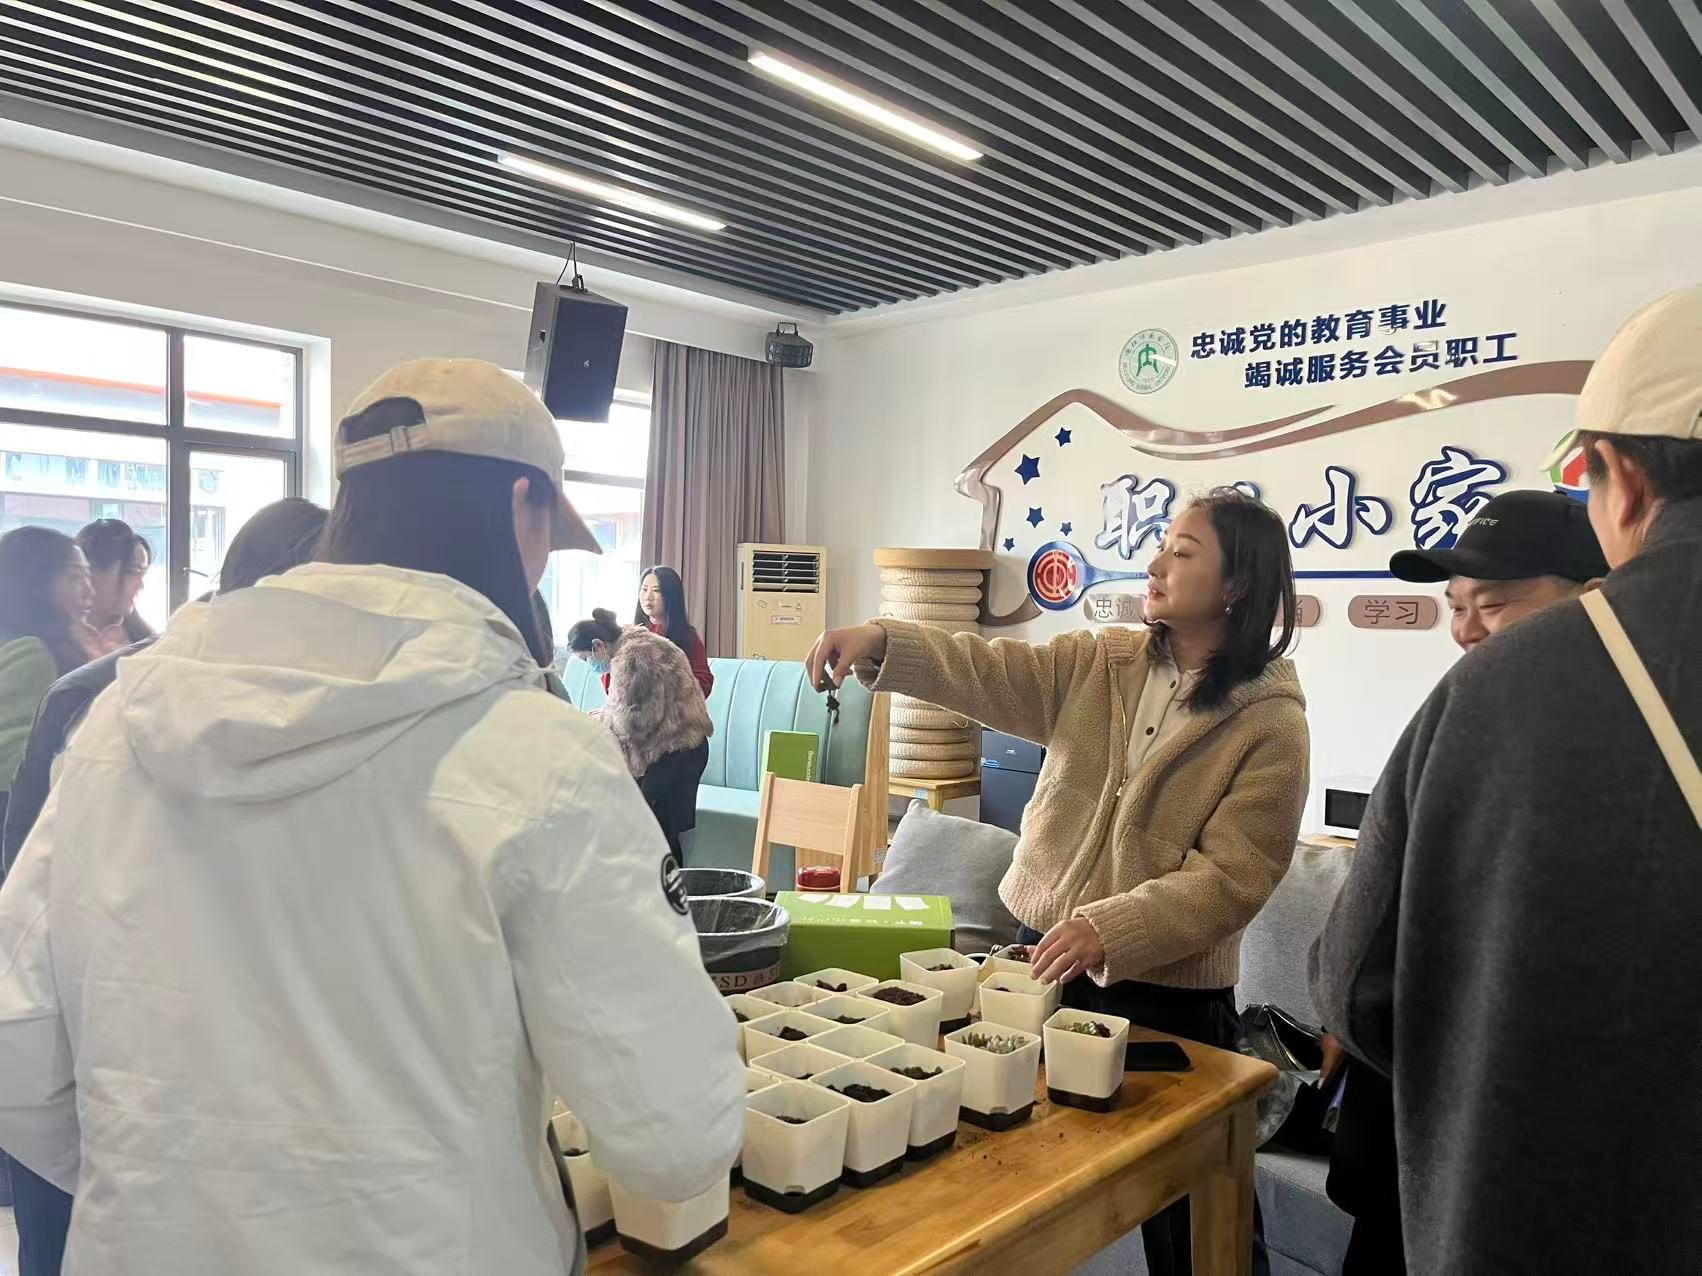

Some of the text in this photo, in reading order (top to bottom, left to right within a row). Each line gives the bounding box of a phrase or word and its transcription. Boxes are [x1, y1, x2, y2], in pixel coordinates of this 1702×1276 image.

[1190, 298, 1447, 359] 忠诚党的教育事业
[1244, 331, 1518, 389] 竭诚服务会员职工
[1094, 445, 1508, 561] 职小家
[1094, 596, 1137, 619] 忠诚
[1364, 600, 1419, 625] 学习
